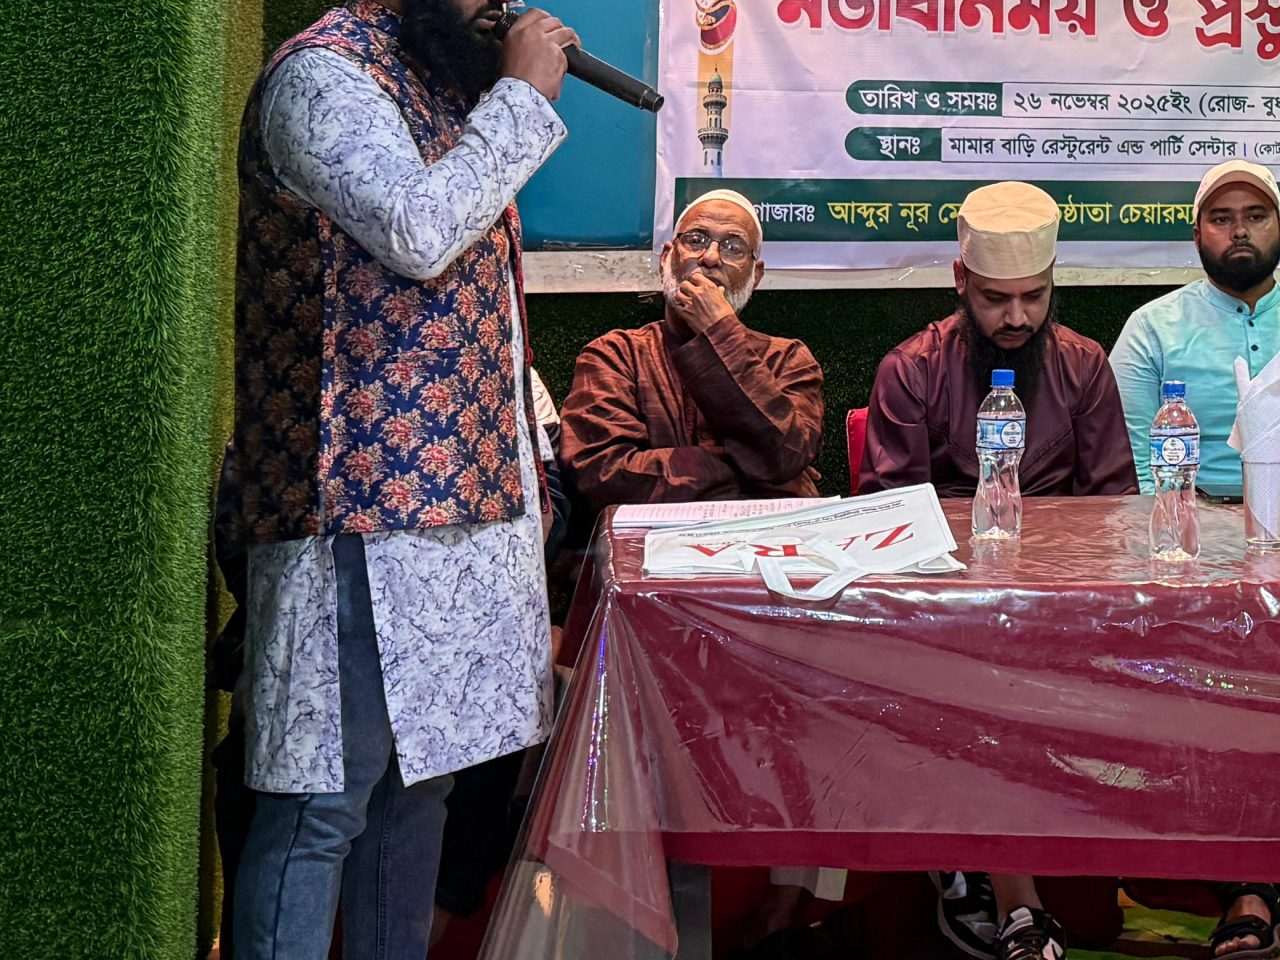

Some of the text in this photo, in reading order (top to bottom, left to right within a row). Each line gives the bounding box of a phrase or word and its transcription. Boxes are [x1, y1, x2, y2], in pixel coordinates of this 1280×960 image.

[858, 84, 919, 110] তারিখ
[924, 92, 941, 109] ও
[946, 91, 998, 111] সময়ঃ
[1013, 92, 1042, 112] ২৬
[1049, 92, 1111, 112] নভেম্বর
[1117, 89, 1193, 115] ২০২৫ইং
[876, 134, 921, 159] স্থানঃ
[949, 136, 996, 155] মামার
[1001, 133, 1037, 158] বাড়ি
[1042, 134, 1112, 160] রেস্টুরেন্ট
[1117, 139, 1145, 156] এন্ড
[1150, 135, 1185, 156] পার্টি
[827, 201, 893, 229] আব্দুর
[899, 202, 933, 231] নূর
[1058, 194, 1113, 225] ষ্ঠাতা
[1119, 203, 1196, 226] চেয়ারম
